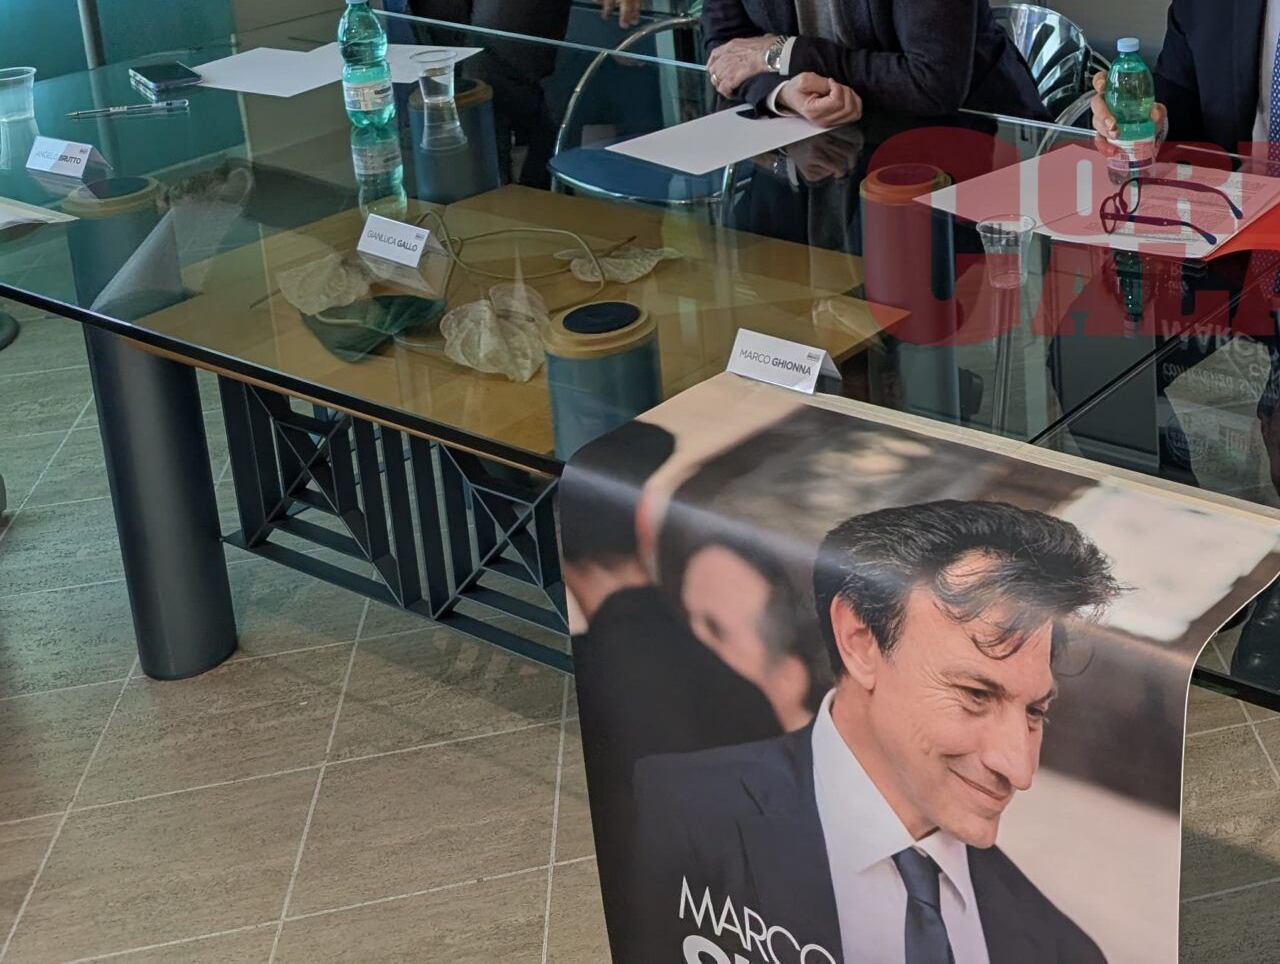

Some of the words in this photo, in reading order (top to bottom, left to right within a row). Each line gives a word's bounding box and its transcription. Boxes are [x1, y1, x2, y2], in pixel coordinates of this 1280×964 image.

[59, 154, 81, 164] BRUTTO
[367, 229, 396, 245] GIANLUCA
[397, 239, 418, 252] GALLO
[739, 349, 770, 365] MARCO
[771, 357, 812, 376] GHIONNA
